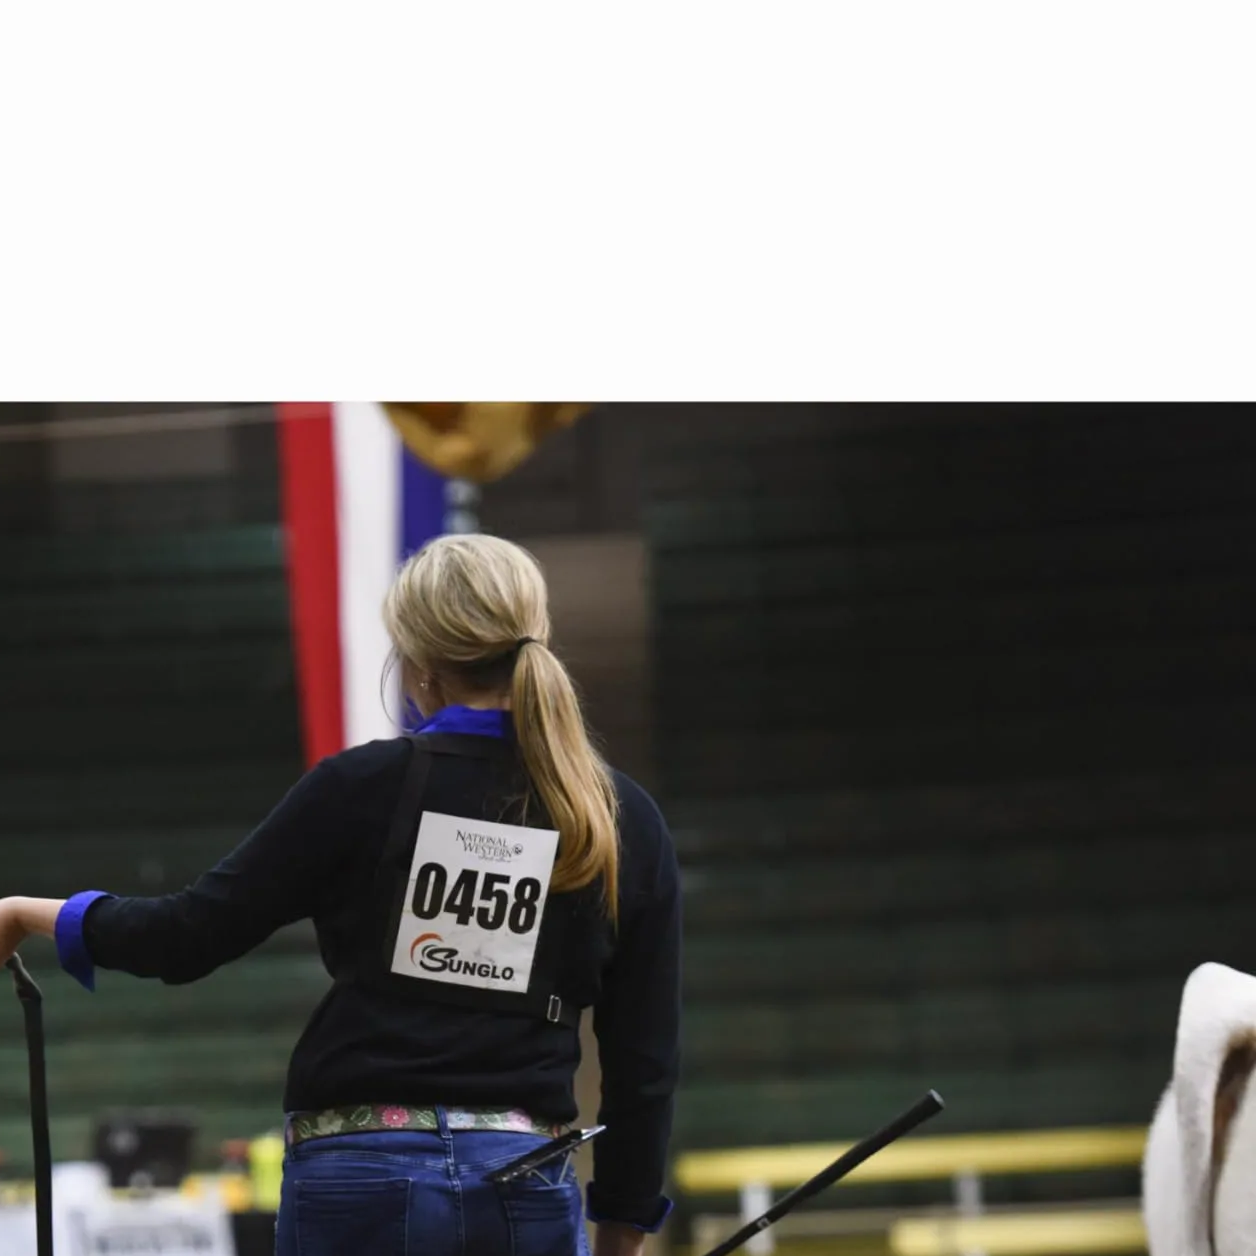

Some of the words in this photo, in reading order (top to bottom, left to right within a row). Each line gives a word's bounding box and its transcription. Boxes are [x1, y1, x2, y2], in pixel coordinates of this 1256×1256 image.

[455, 829, 508, 847] NATIONAL
[463, 841, 512, 858] WESTERN
[411, 862, 541, 934] 0458
[419, 945, 515, 980] SUNGLO
